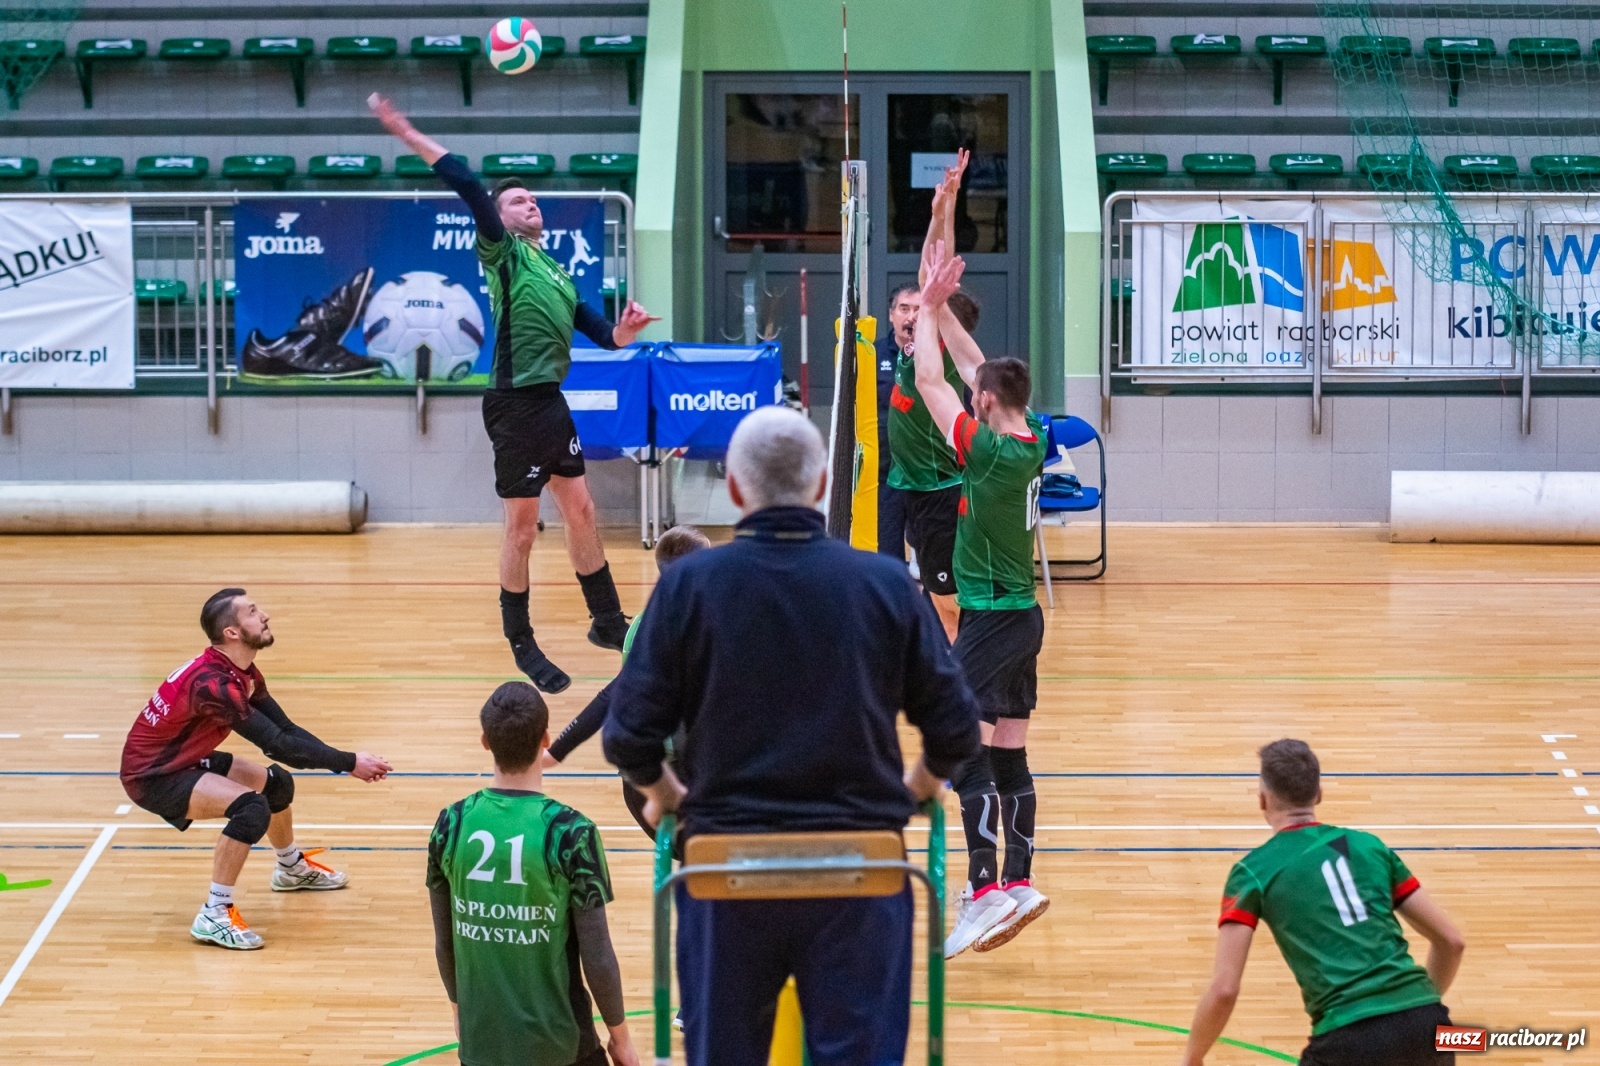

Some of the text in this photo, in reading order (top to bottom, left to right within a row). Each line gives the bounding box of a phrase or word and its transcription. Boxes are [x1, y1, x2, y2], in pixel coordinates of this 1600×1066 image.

[436, 213, 470, 225] Sklep
[1171, 317, 1400, 347] powiat racborski
[1171, 348, 1247, 363] zielona
[670, 390, 756, 411] molten
[466, 829, 528, 886] 21
[1321, 855, 1369, 927] 11
[468, 900, 557, 922] PŁOMIEŃ
